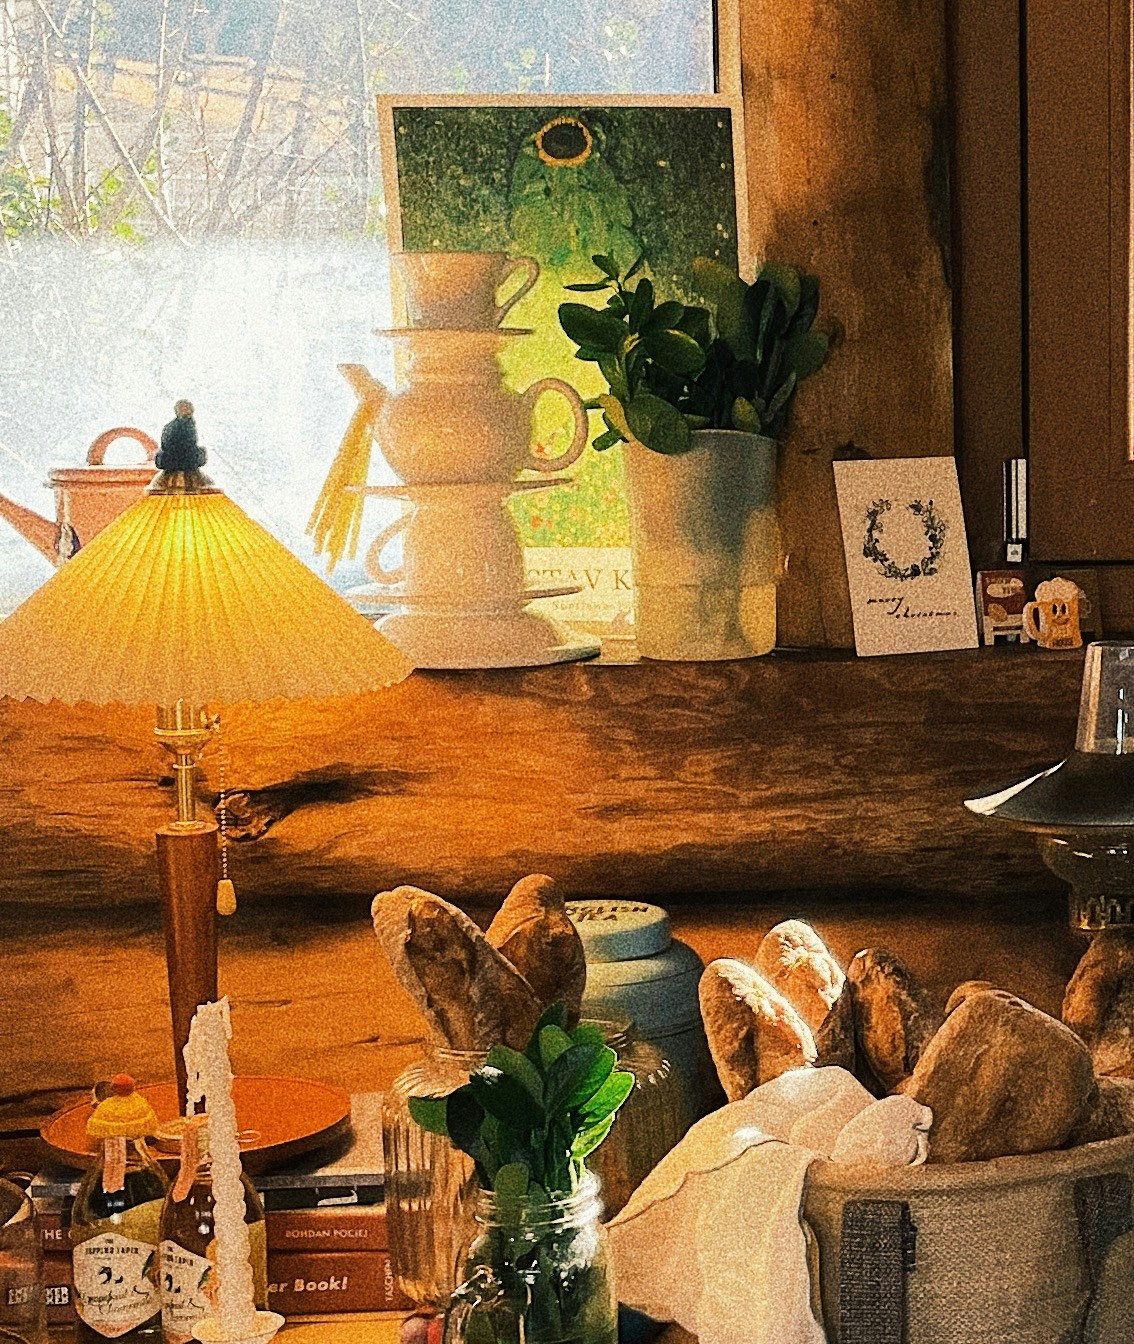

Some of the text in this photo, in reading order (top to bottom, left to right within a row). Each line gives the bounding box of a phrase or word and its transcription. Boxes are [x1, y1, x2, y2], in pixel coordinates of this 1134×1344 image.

[285, 1229, 331, 1239] BOHDAN
[268, 1275, 349, 1293] er Book!
